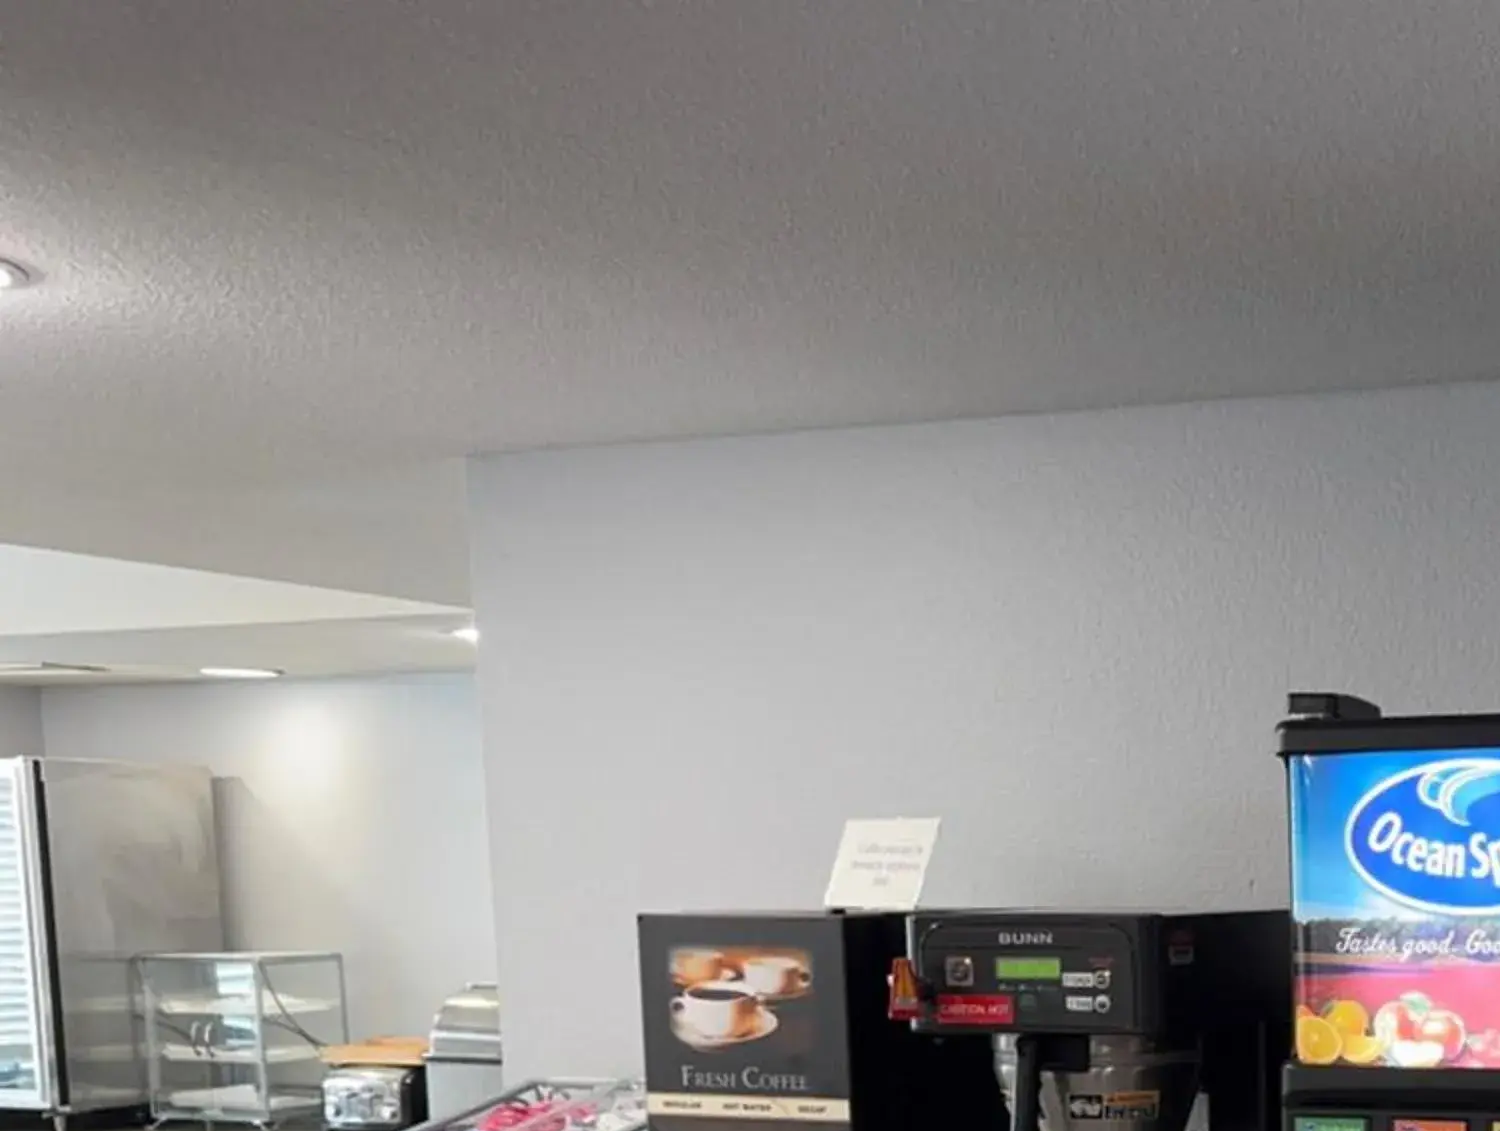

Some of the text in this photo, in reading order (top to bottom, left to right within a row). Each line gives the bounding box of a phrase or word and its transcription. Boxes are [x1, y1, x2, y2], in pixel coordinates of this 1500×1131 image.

[1367, 811, 1466, 879] Ocean
[997, 932, 1053, 945] BUNN
[1335, 926, 1397, 955] Tastes
[1400, 930, 1459, 963] good.
[680, 1064, 808, 1091] FRESH COFFEE
